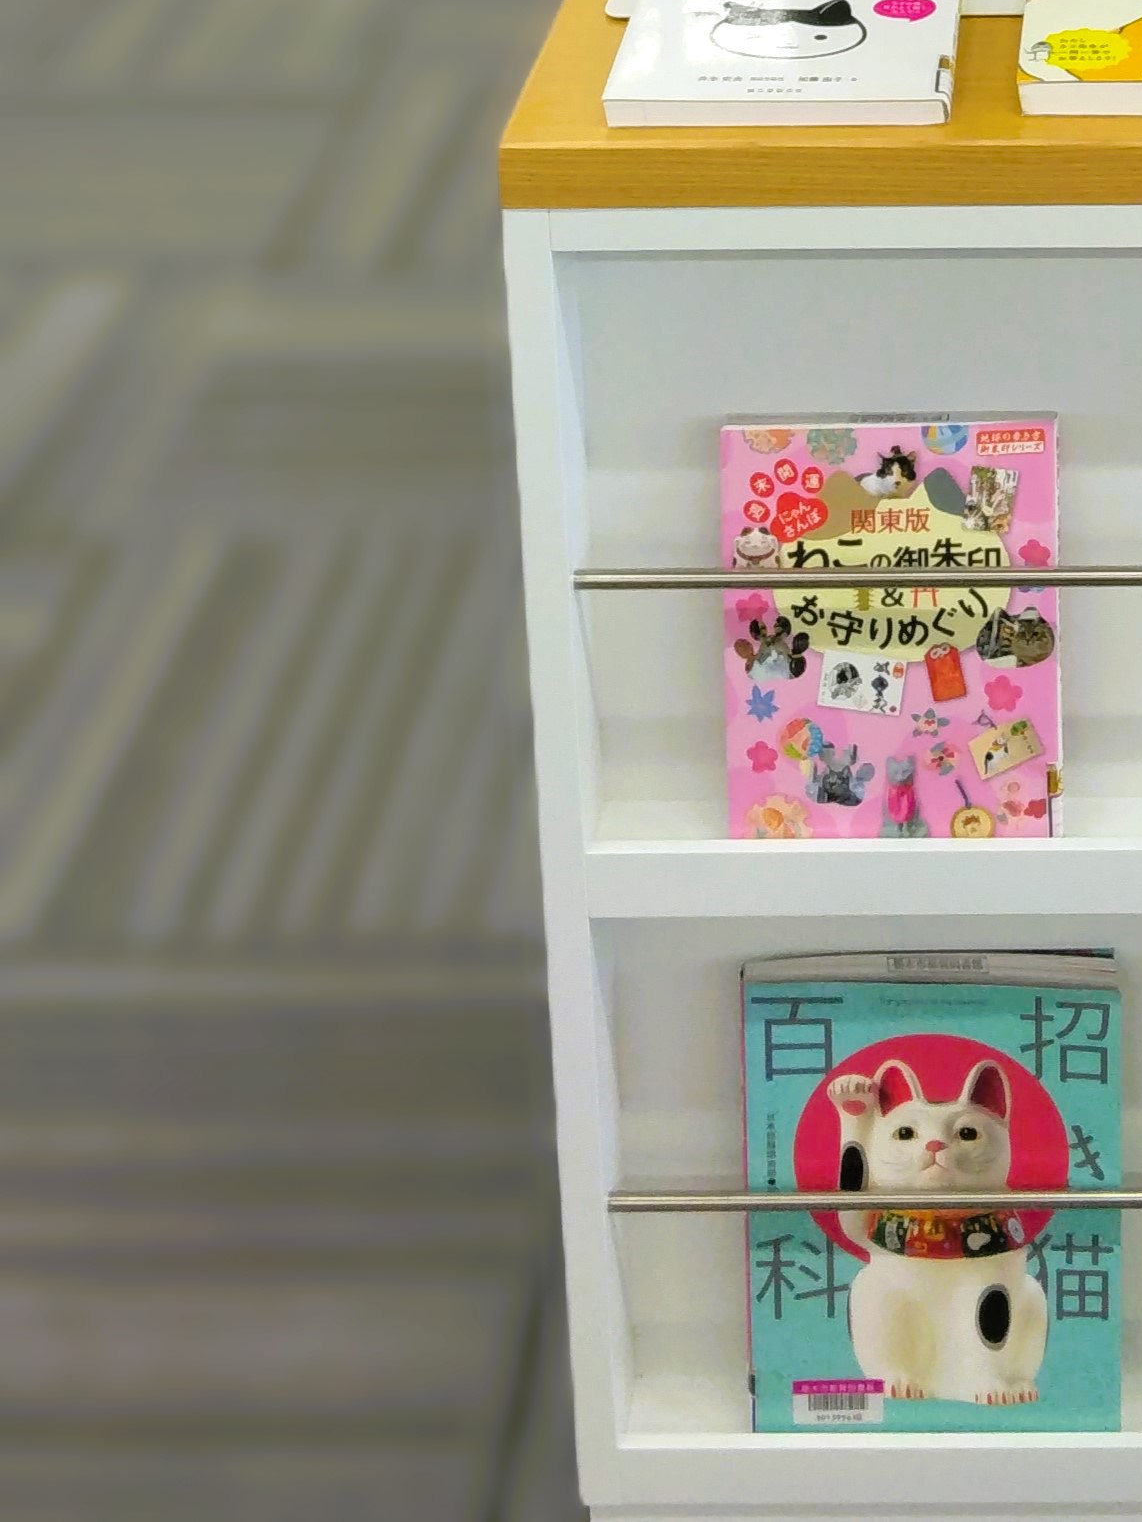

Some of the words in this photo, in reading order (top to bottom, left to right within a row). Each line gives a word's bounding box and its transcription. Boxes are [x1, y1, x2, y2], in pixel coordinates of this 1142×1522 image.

[851, 508, 930, 533] 関東版
[791, 588, 988, 649] お守りめぐり
